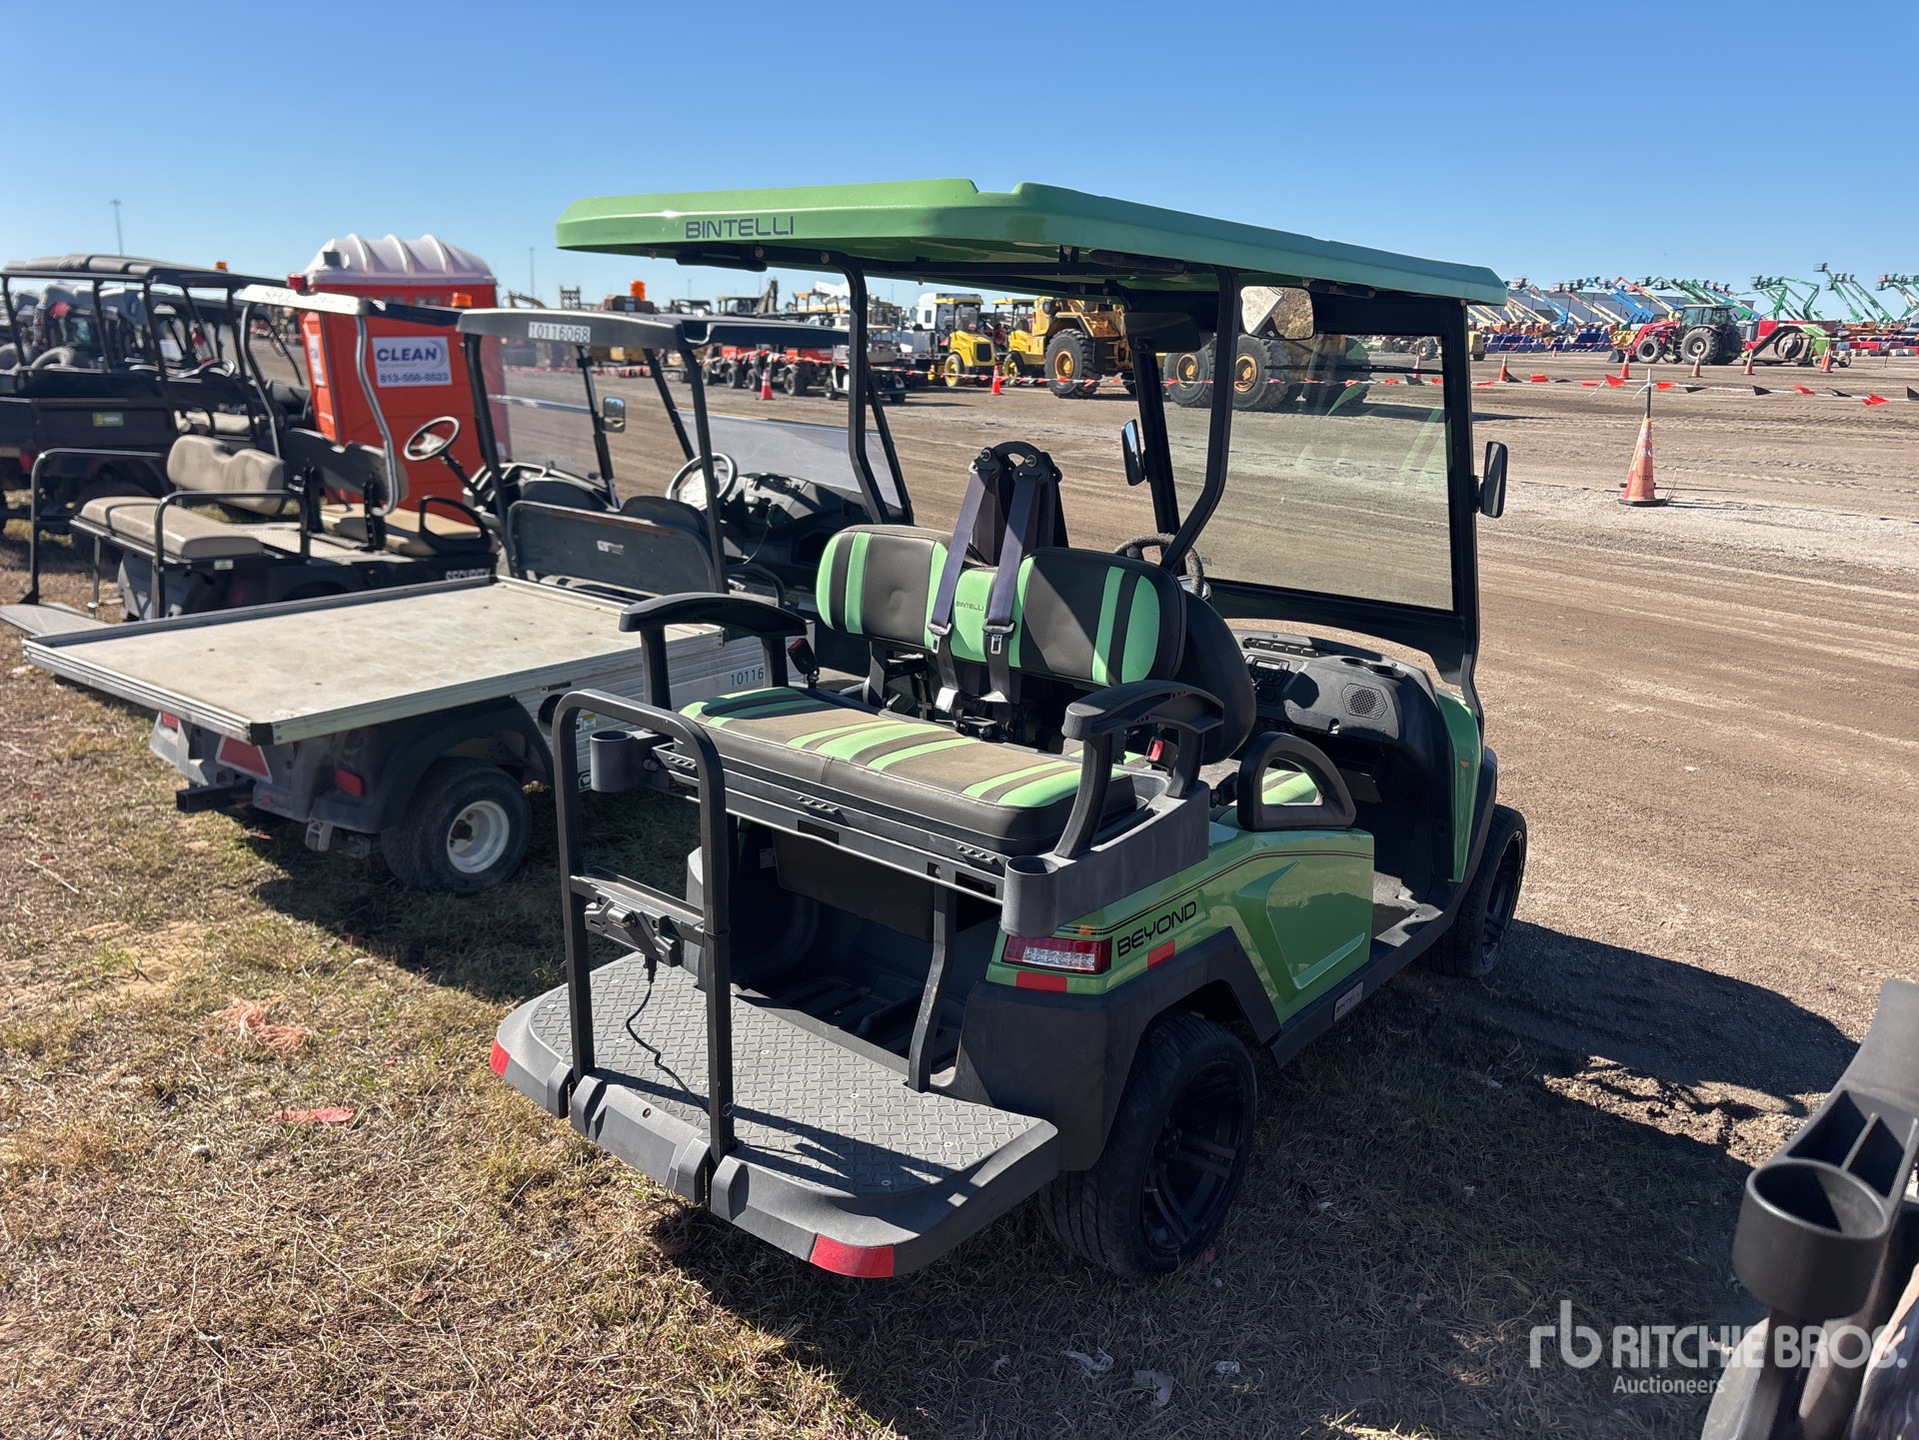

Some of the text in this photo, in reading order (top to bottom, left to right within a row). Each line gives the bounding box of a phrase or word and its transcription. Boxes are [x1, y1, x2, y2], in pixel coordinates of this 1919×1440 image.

[685, 216, 794, 239] BINTELLI
[529, 324, 589, 342] 10116068
[376, 346, 438, 362] CLEAN
[730, 667, 765, 686] 10116
[1117, 901, 1197, 958] BEYOND
